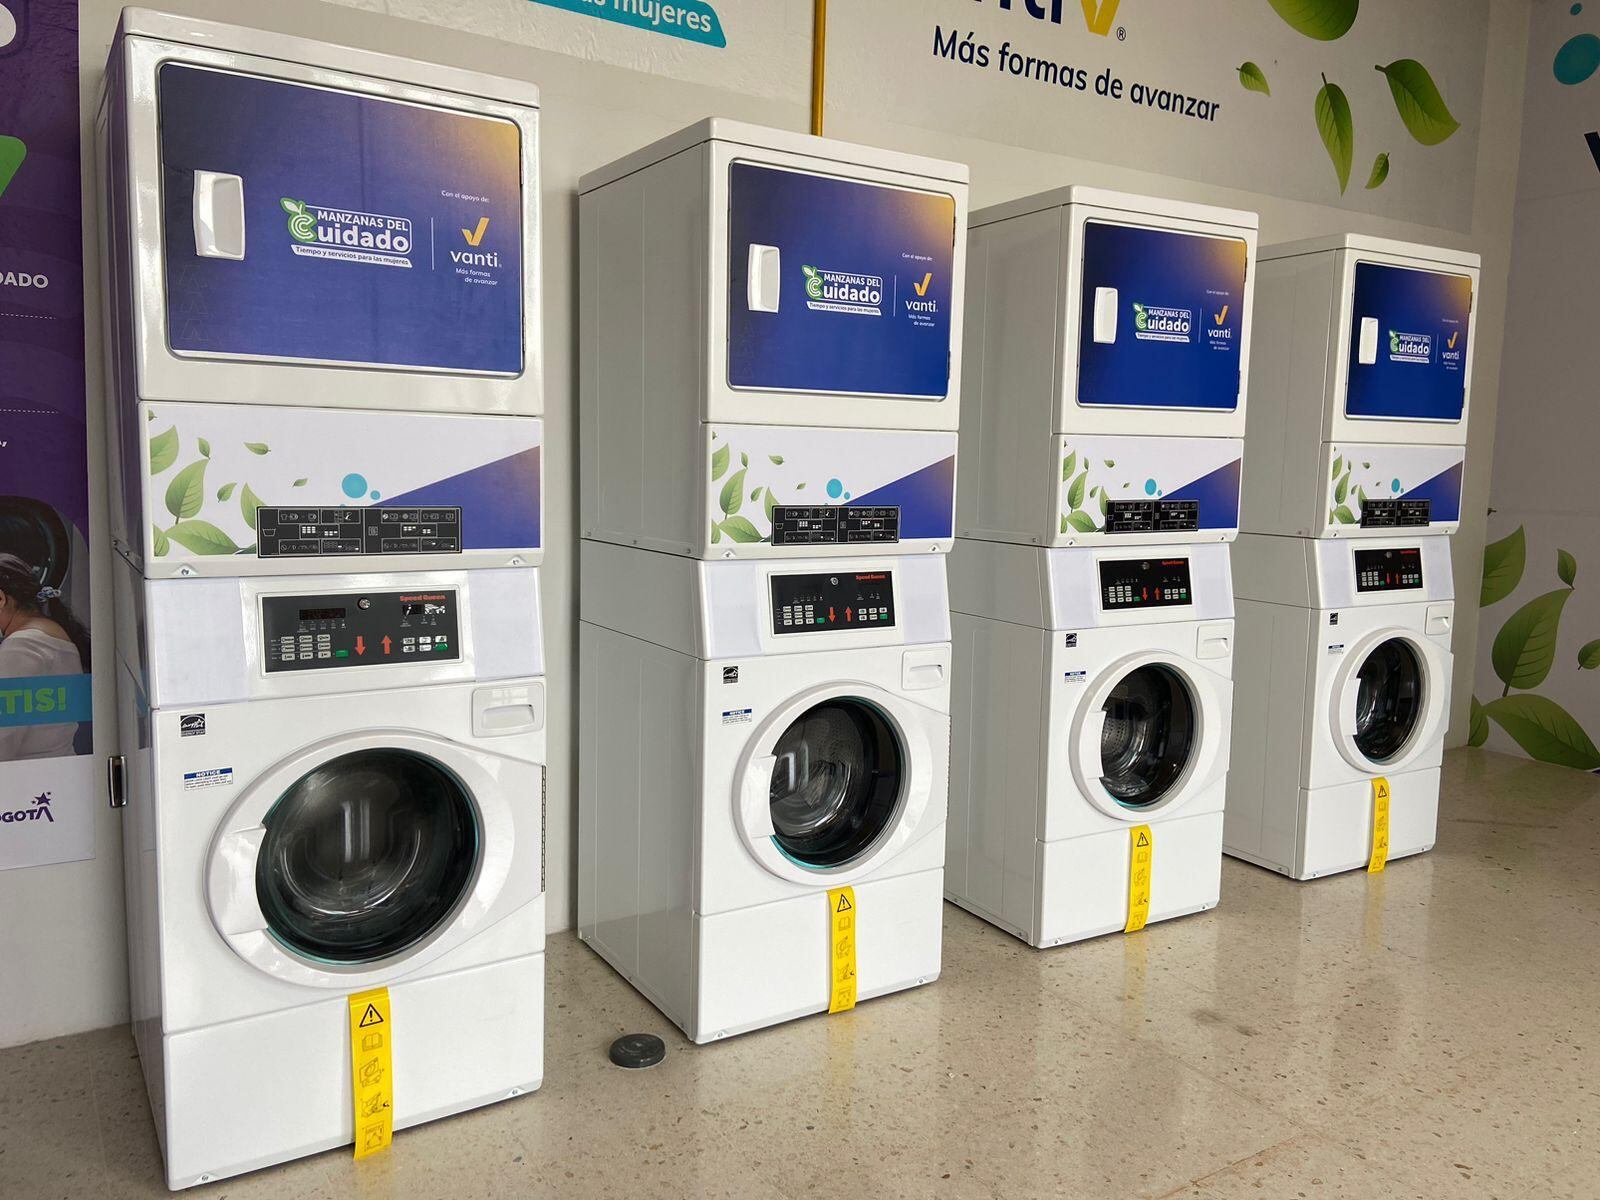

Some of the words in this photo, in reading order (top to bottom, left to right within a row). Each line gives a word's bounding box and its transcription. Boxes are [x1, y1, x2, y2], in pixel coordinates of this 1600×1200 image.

[932, 25, 990, 67] Más
[998, 42, 1088, 91] formas
[1095, 68, 1123, 99] de
[1130, 83, 1220, 122] avanzar
[441, 190, 454, 198] Con
[317, 210, 384, 229] MANZANAS
[387, 219, 409, 232] DEL
[290, 214, 410, 252] Cuidado
[296, 246, 322, 255] Tiempo
[328, 250, 358, 259] servicios
[357, 253, 372, 261] para
[382, 257, 410, 266] mujeres
[450, 250, 498, 268] vanti
[0, 271, 49, 289] ADO
[455, 267, 469, 275] Más
[469, 269, 491, 277] formas
[823, 273, 866, 286] MANZANAS
[866, 278, 881, 287] DEL
[473, 278, 498, 286] avanzar
[807, 277, 881, 303] Cuidado
[905, 299, 936, 313] vanti
[1148, 308, 1179, 318] MANZANAS
[1179, 311, 1190, 319] DEL
[1136, 312, 1189, 333] Cuidado
[1207, 327, 1231, 339] vanti
[195, 769, 221, 778] NOTICE
